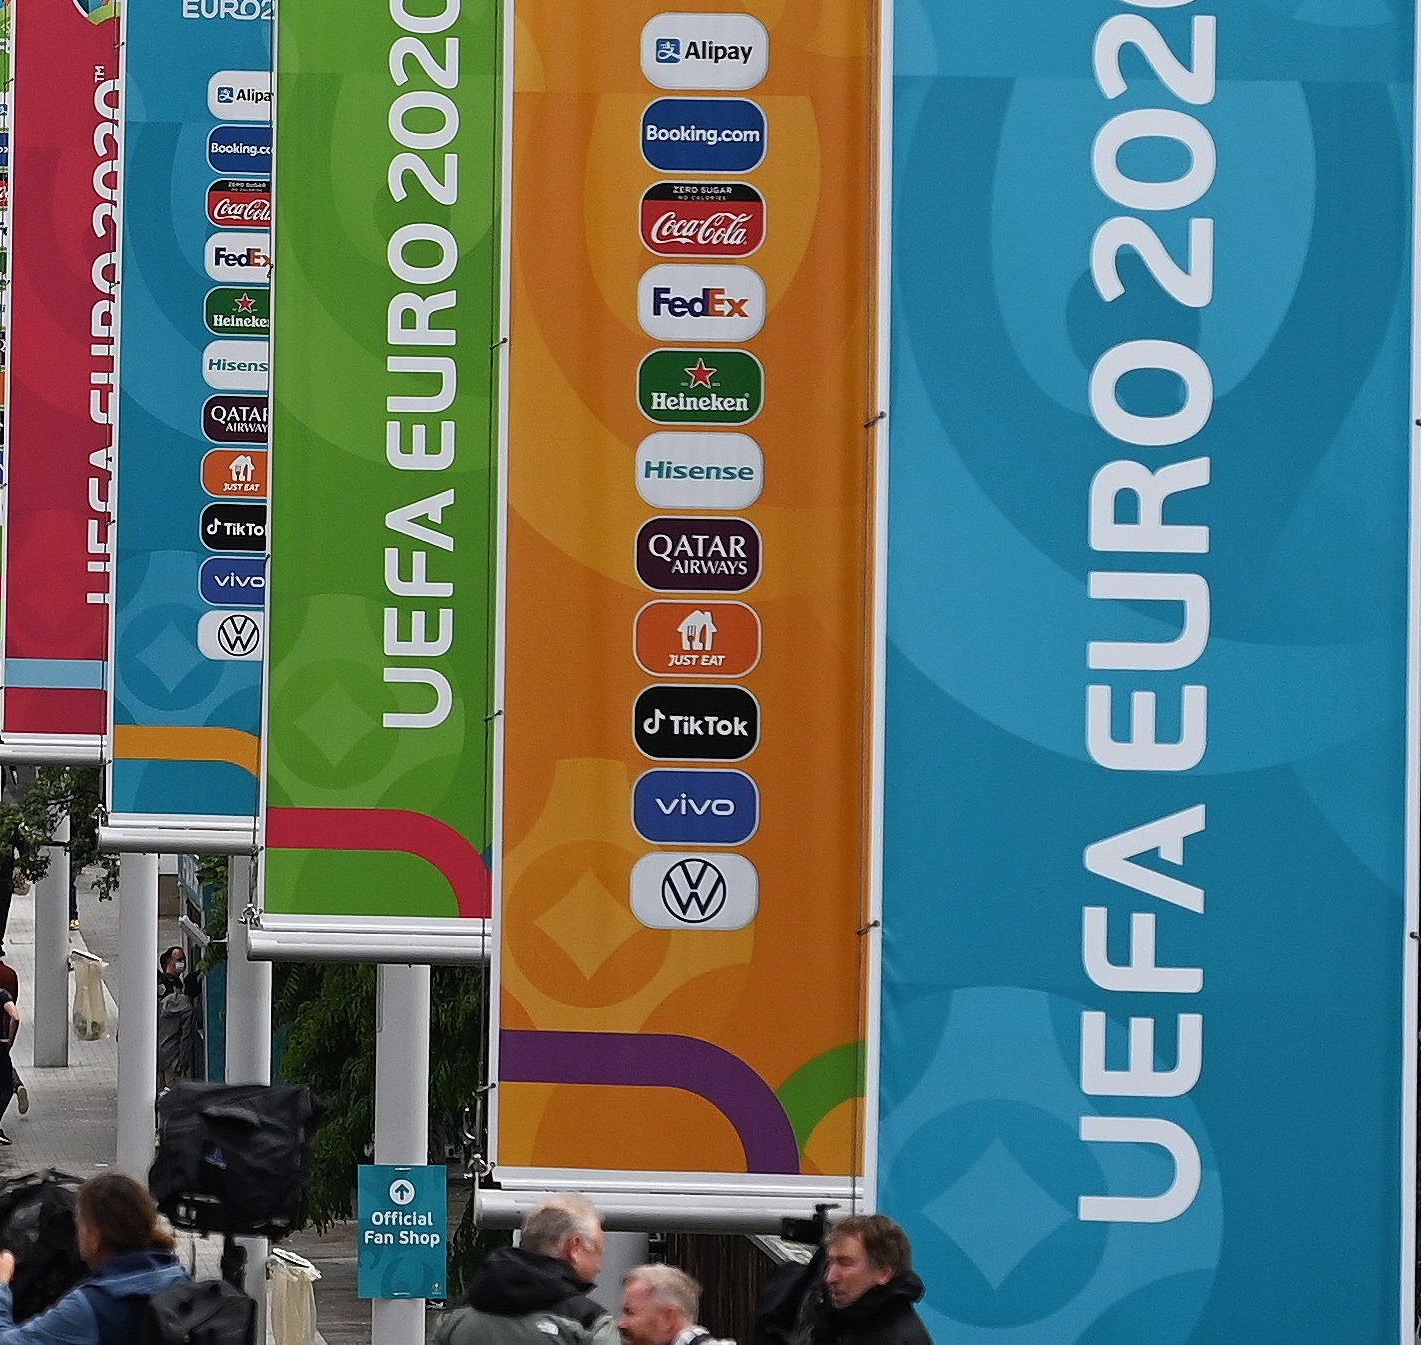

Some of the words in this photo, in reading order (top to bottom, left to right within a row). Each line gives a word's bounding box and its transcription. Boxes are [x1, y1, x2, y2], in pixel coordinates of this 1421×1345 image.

[684, 40, 753, 64] Alipay
[236, 88, 273, 103] Alipa
[646, 125, 760, 145] Booking.com
[651, 211, 752, 245] Coca-Cola
[652, 287, 750, 318] FedEx
[386, 222, 458, 470] EURO
[208, 358, 268, 372] Hisens
[651, 392, 750, 411] Heineken
[226, 422, 268, 432] AIRWAY
[644, 461, 754, 481] Hisense
[224, 522, 267, 535] TikTo
[648, 534, 747, 560] QATAR
[1085, 336, 1213, 773] EURO
[671, 560, 748, 576] AIRWAYS
[214, 572, 265, 587] vivo
[382, 488, 456, 729] UEFA
[668, 655, 699, 667] JUST
[700, 655, 726, 667] EAT
[669, 715, 749, 736] TikTok
[655, 793, 735, 816] vivo
[1078, 803, 1206, 1224] UEFA
[371, 1211, 433, 1226] Official
[364, 1230, 394, 1244] Fan
[399, 1230, 440, 1248] Shop
